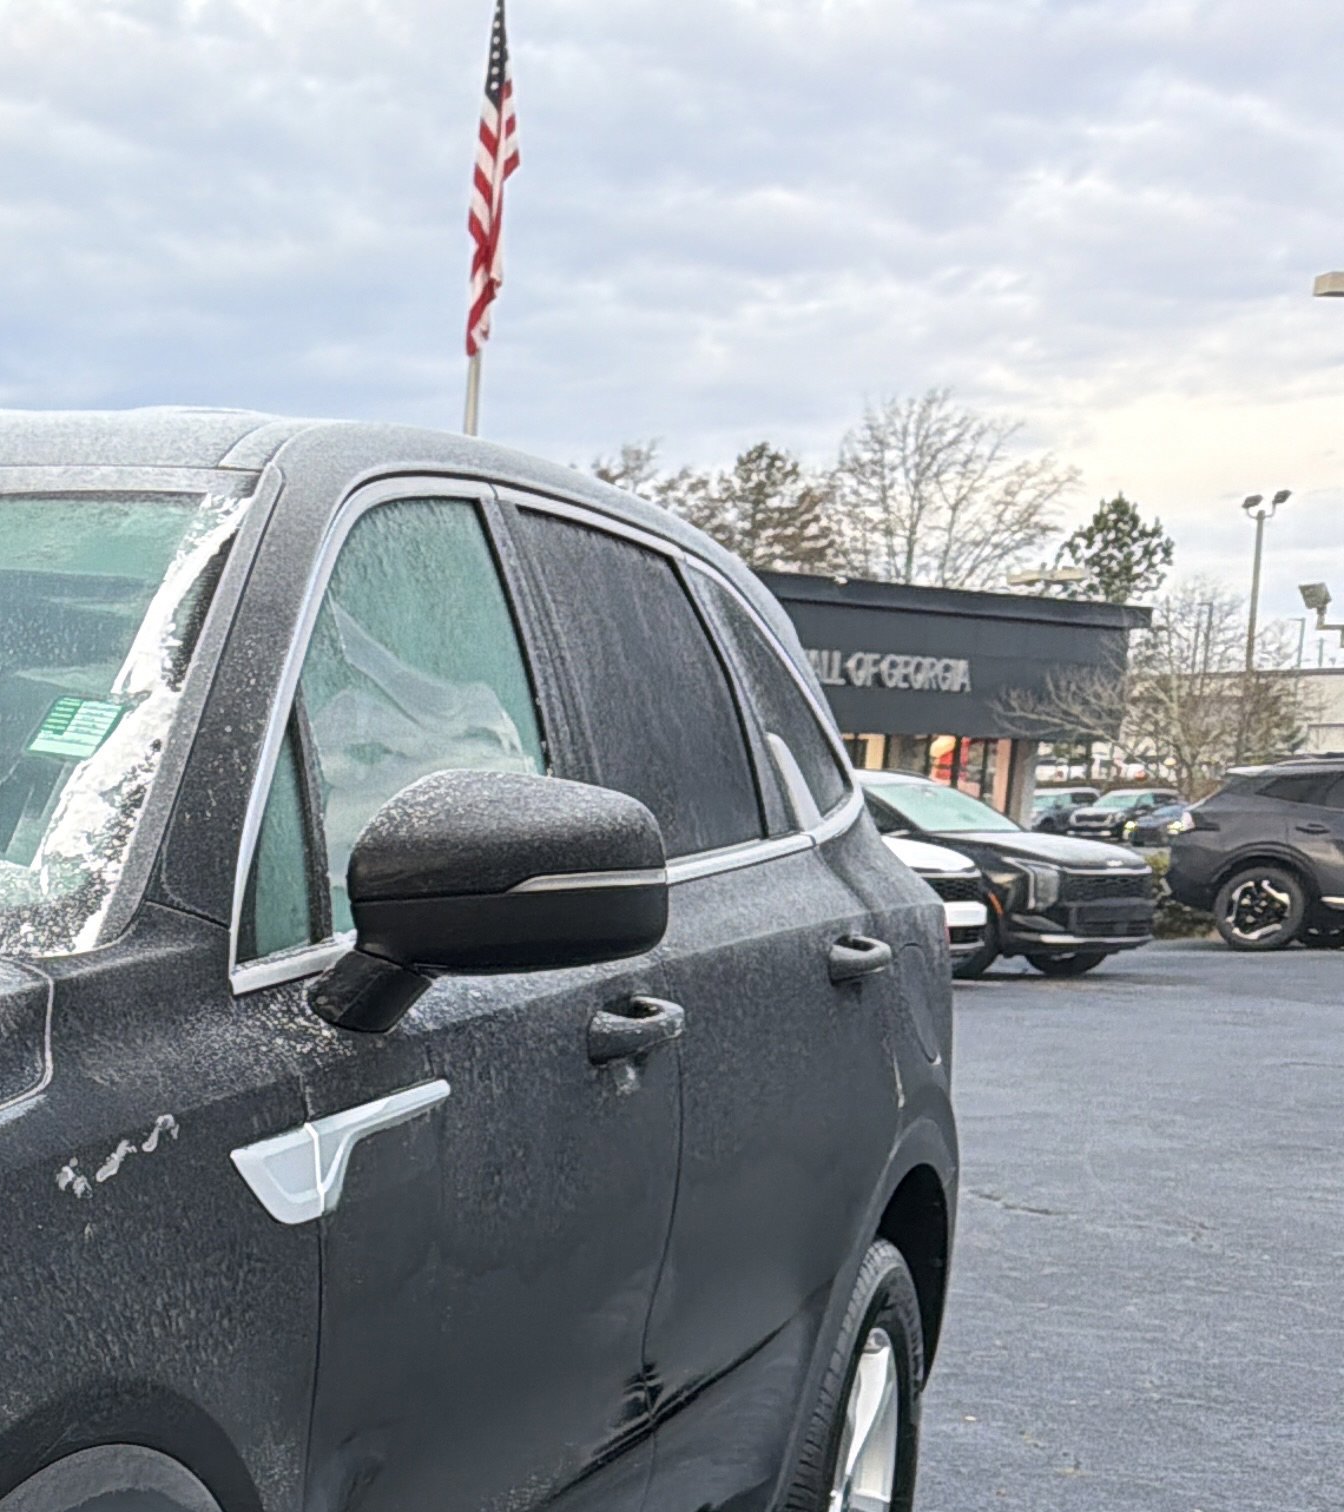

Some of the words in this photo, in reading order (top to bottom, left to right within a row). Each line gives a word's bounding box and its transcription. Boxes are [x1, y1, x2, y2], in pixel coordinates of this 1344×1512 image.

[803, 649, 846, 686] ALL
[846, 652, 881, 687] OF
[880, 653, 972, 693] GEORGIA
